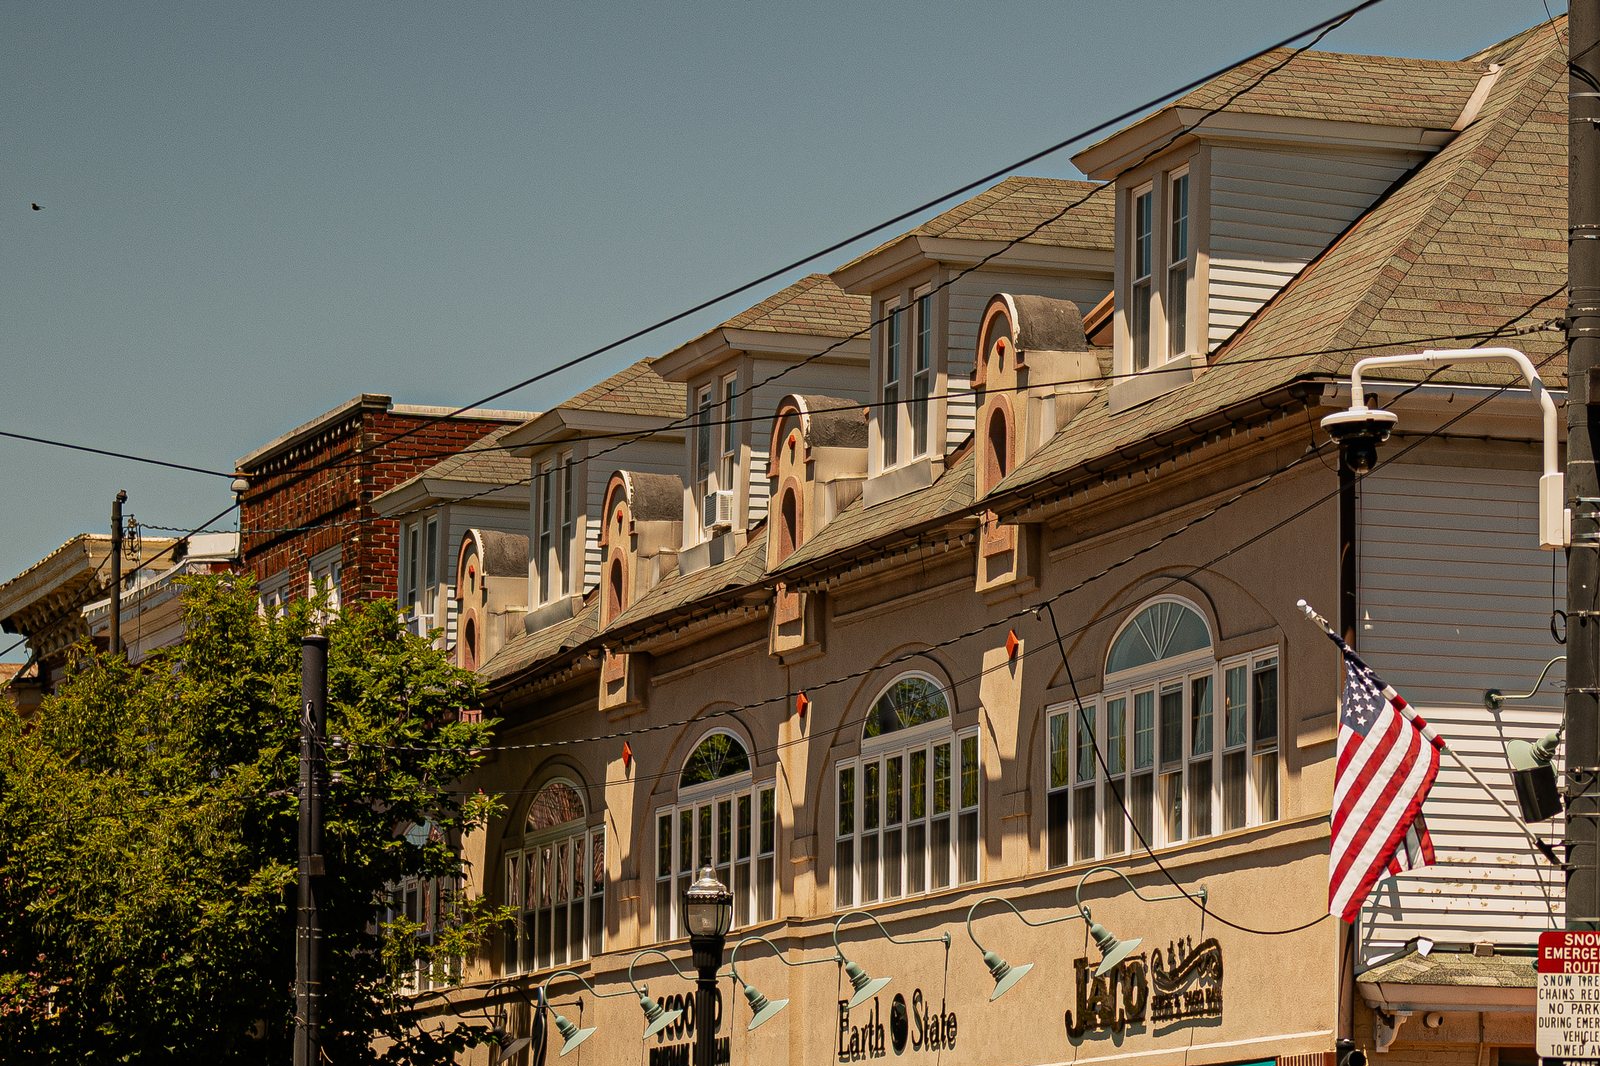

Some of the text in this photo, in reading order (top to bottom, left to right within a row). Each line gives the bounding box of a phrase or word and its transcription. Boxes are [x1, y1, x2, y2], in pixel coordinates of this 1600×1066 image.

[1544, 975, 1572, 986] SNOW
[1065, 956, 1148, 1038] JACO
[1539, 989, 1574, 1000] CHAINS
[1548, 1003, 1564, 1014] NO
[838, 988, 958, 1056] Earth State
[1539, 1017, 1572, 1028] DURING
[1551, 1044, 1584, 1056] TOWED
